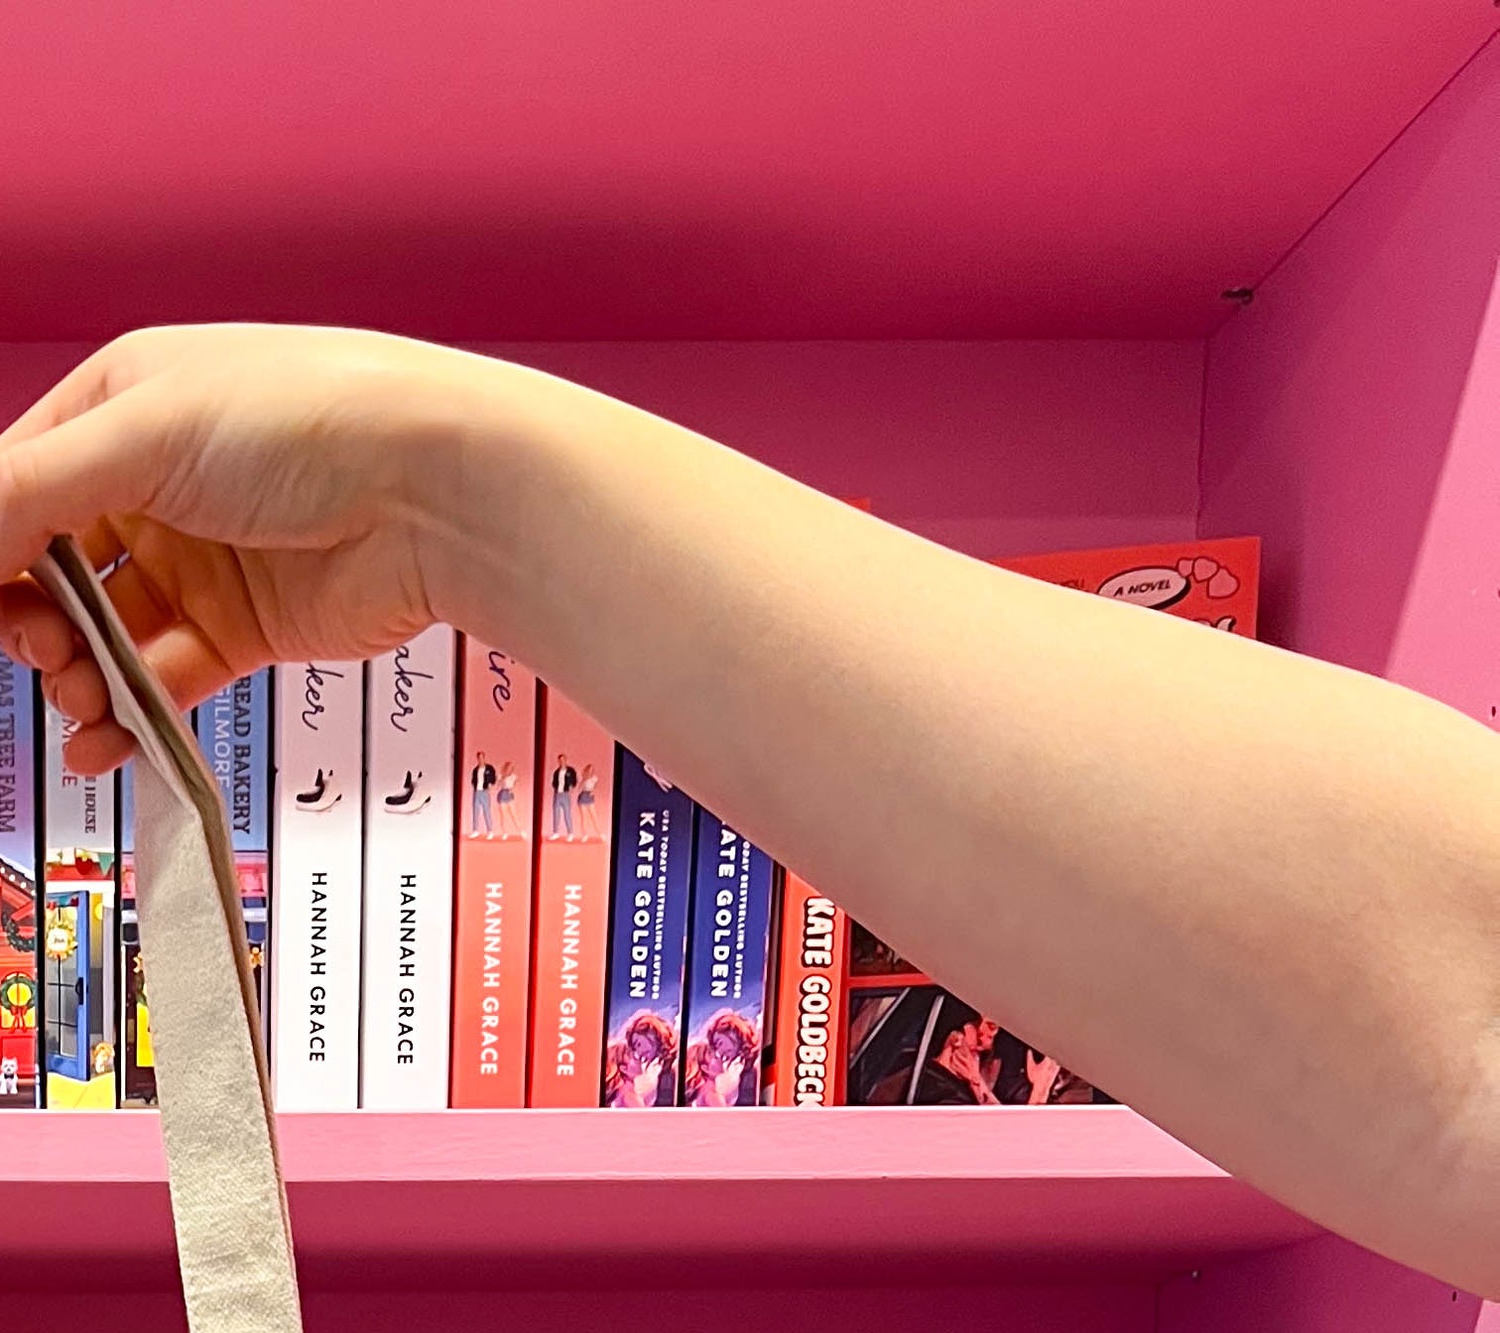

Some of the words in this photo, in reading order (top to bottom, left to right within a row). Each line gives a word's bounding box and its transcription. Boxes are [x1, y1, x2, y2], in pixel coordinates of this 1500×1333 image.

[1114, 584, 1127, 596] A
[1129, 578, 1171, 594] NOVEL
[0, 772, 16, 832] FARM
[636, 812, 654, 879] KATE
[310, 872, 327, 975] HANNAH
[630, 892, 652, 998] GOLDEN
[804, 897, 835, 966] KATE
[309, 986, 325, 1062] GRACE
